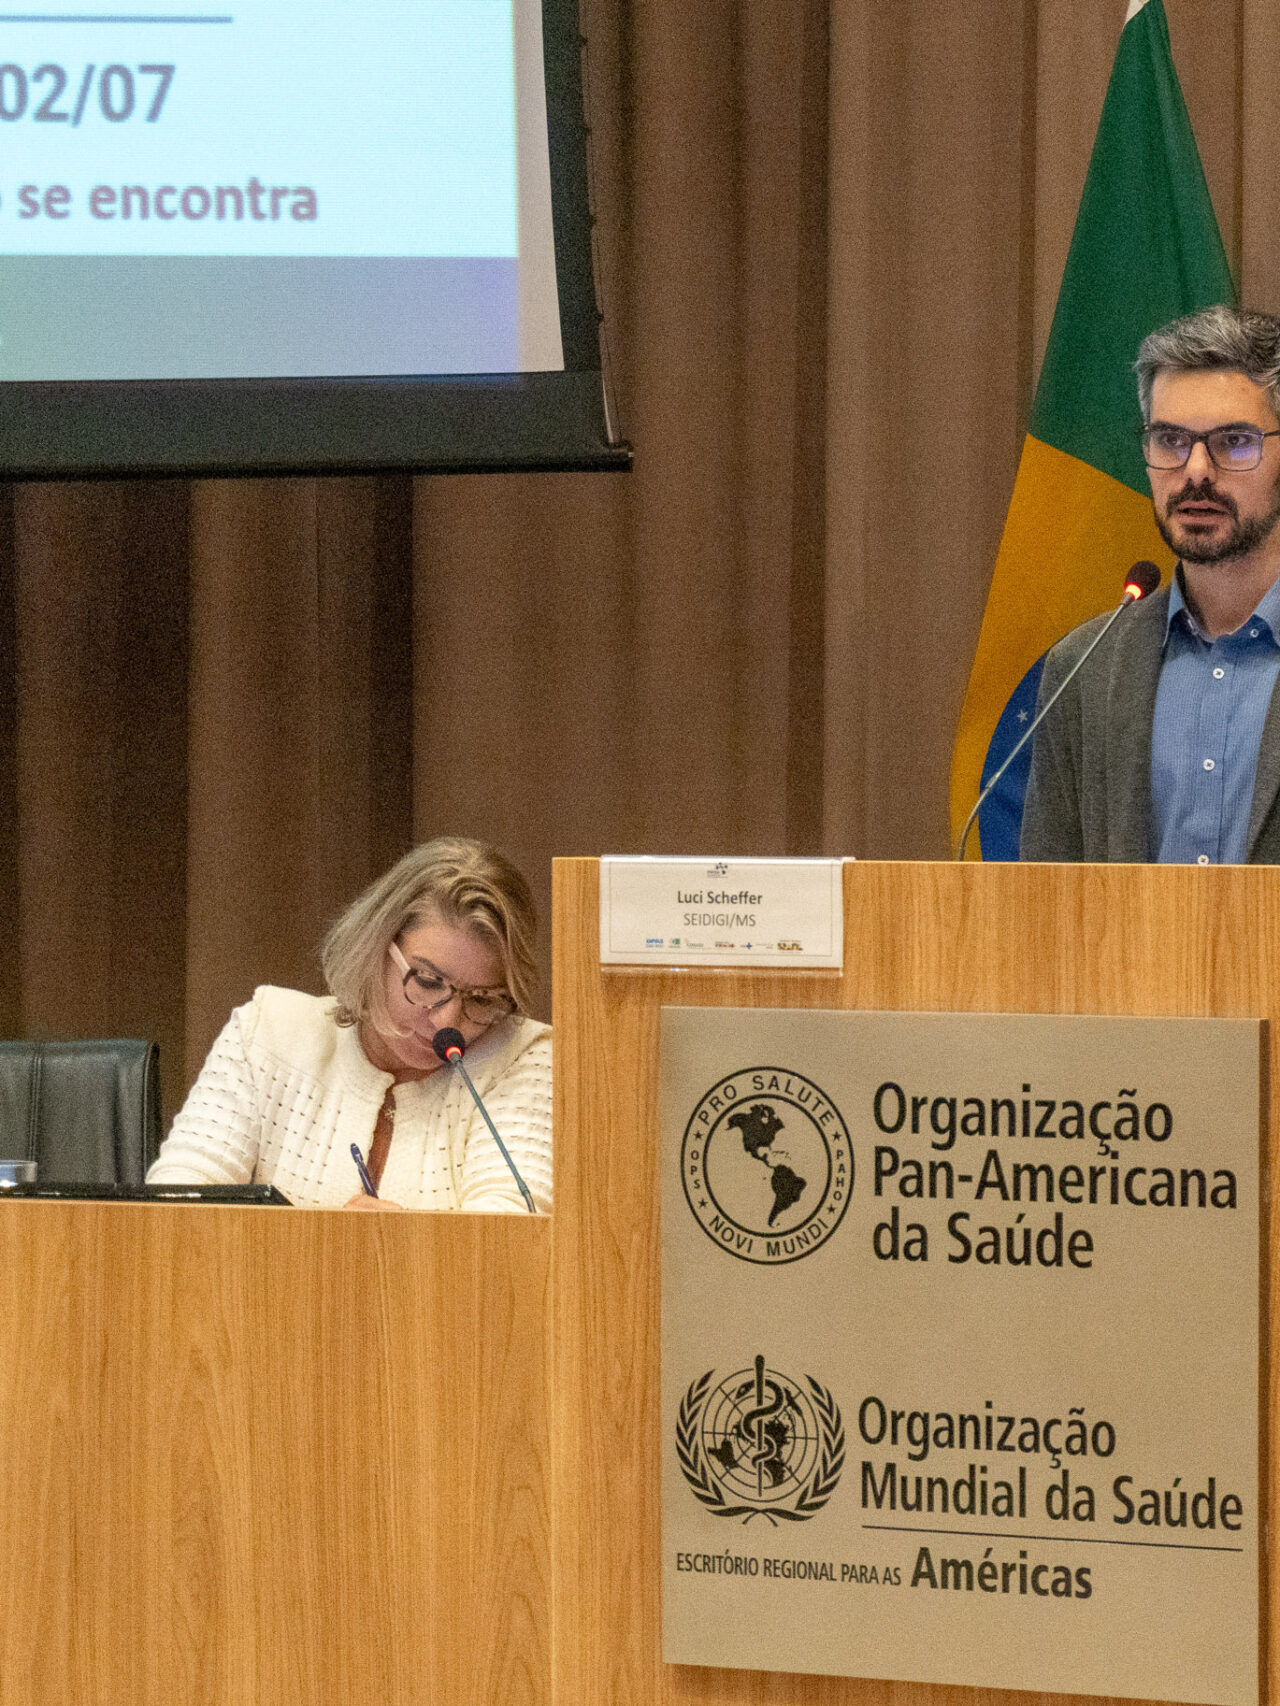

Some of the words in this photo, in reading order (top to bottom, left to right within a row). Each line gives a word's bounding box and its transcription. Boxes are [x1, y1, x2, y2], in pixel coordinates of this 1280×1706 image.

[0, 63, 176, 128] 02/07
[18, 184, 71, 220] se
[89, 177, 318, 221] encontra
[677, 890, 703, 904] Luci
[707, 890, 763, 905] Scheffer
[683, 912, 756, 928] SEIDIGI/MS
[697, 1084, 738, 1126] PRO
[752, 1074, 835, 1127] SALUTE
[872, 1081, 1174, 1160] Organização
[690, 1150, 701, 1189] OPS
[836, 1150, 847, 1201] PAHO
[873, 1145, 1238, 1210] Pan-Americana
[708, 1215, 754, 1254] NOVI
[765, 1218, 829, 1257] MUNDI
[872, 1205, 929, 1263] da
[946, 1211, 1095, 1270] Saúde
[858, 1396, 1117, 1470] Organização
[861, 1460, 1028, 1518] Mundial
[1045, 1468, 1096, 1523] da
[1112, 1475, 1244, 1531] Saúde
[676, 1549, 759, 1576] ESCRITÓRIO
[763, 1558, 837, 1582] REGIONAL
[841, 1563, 879, 1585] PARA
[882, 1567, 901, 1586] AS
[910, 1546, 1093, 1600] Américas
